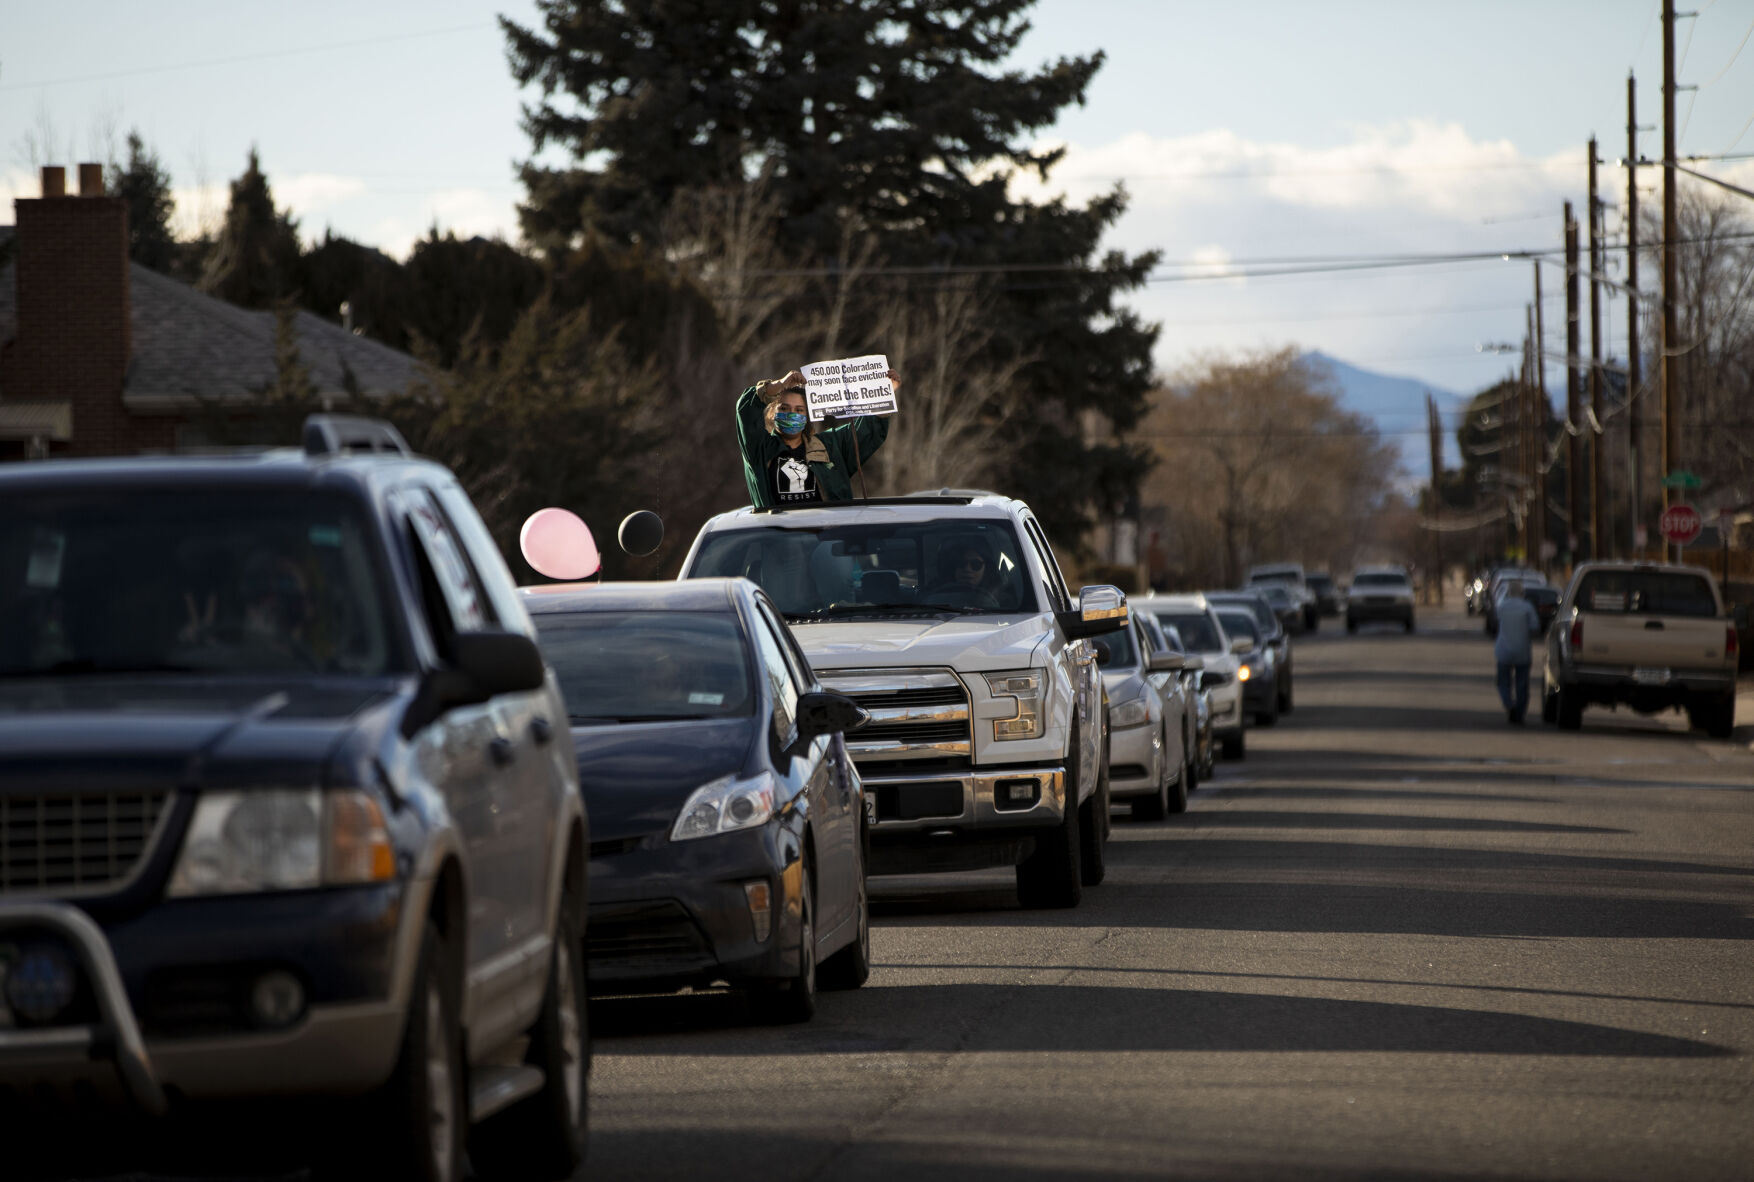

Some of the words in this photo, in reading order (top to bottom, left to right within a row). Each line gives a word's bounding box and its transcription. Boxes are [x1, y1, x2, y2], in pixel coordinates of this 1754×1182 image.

[810, 365, 840, 376] 450,000
[842, 361, 883, 374] Coloradans
[808, 378, 823, 387] may
[824, 376, 841, 385] soon
[842, 374, 858, 383] face
[810, 389, 842, 404] Cancel
[844, 388, 859, 400] the
[861, 384, 892, 399] Rents!
[780, 492, 816, 501] RESIST
[1663, 516, 1698, 533] STOP
